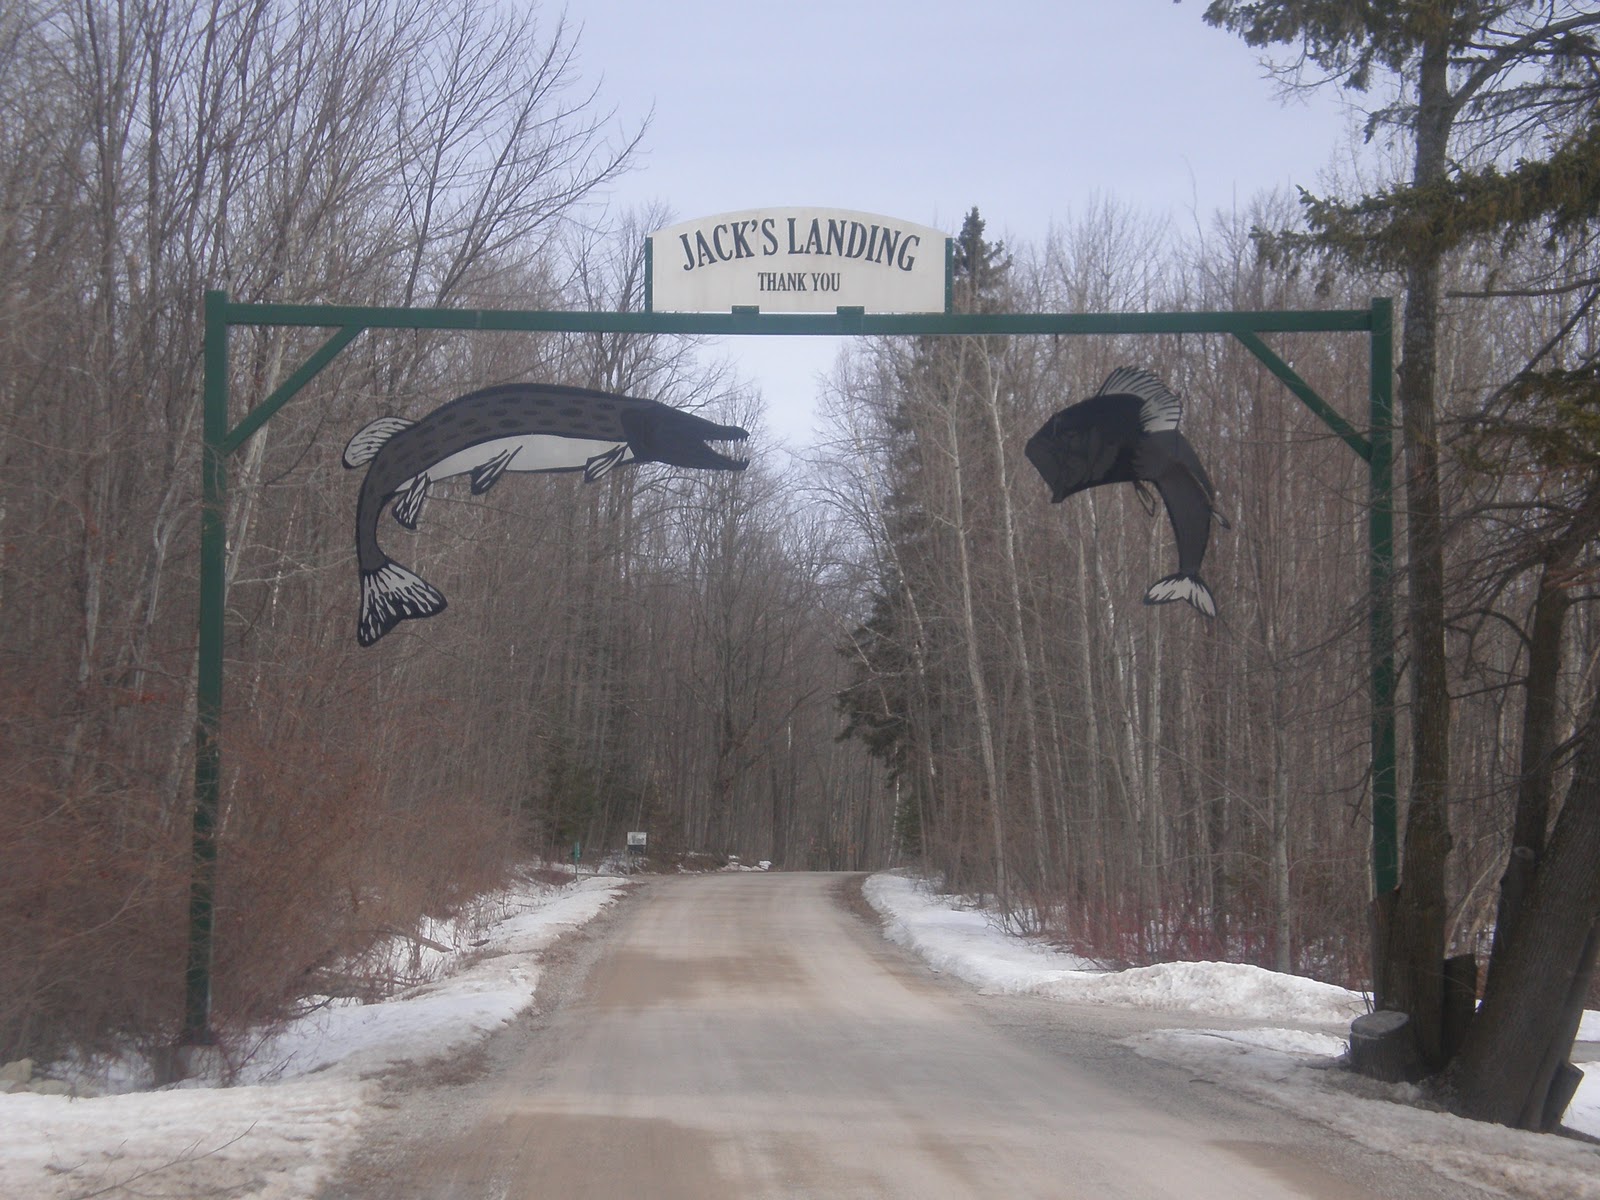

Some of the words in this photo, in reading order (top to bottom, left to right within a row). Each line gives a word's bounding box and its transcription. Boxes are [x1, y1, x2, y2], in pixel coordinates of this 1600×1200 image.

[680, 218, 778, 271] JACK'S
[787, 217, 920, 271] LANDING
[758, 272, 807, 291] THANK
[811, 272, 841, 291] YOU
